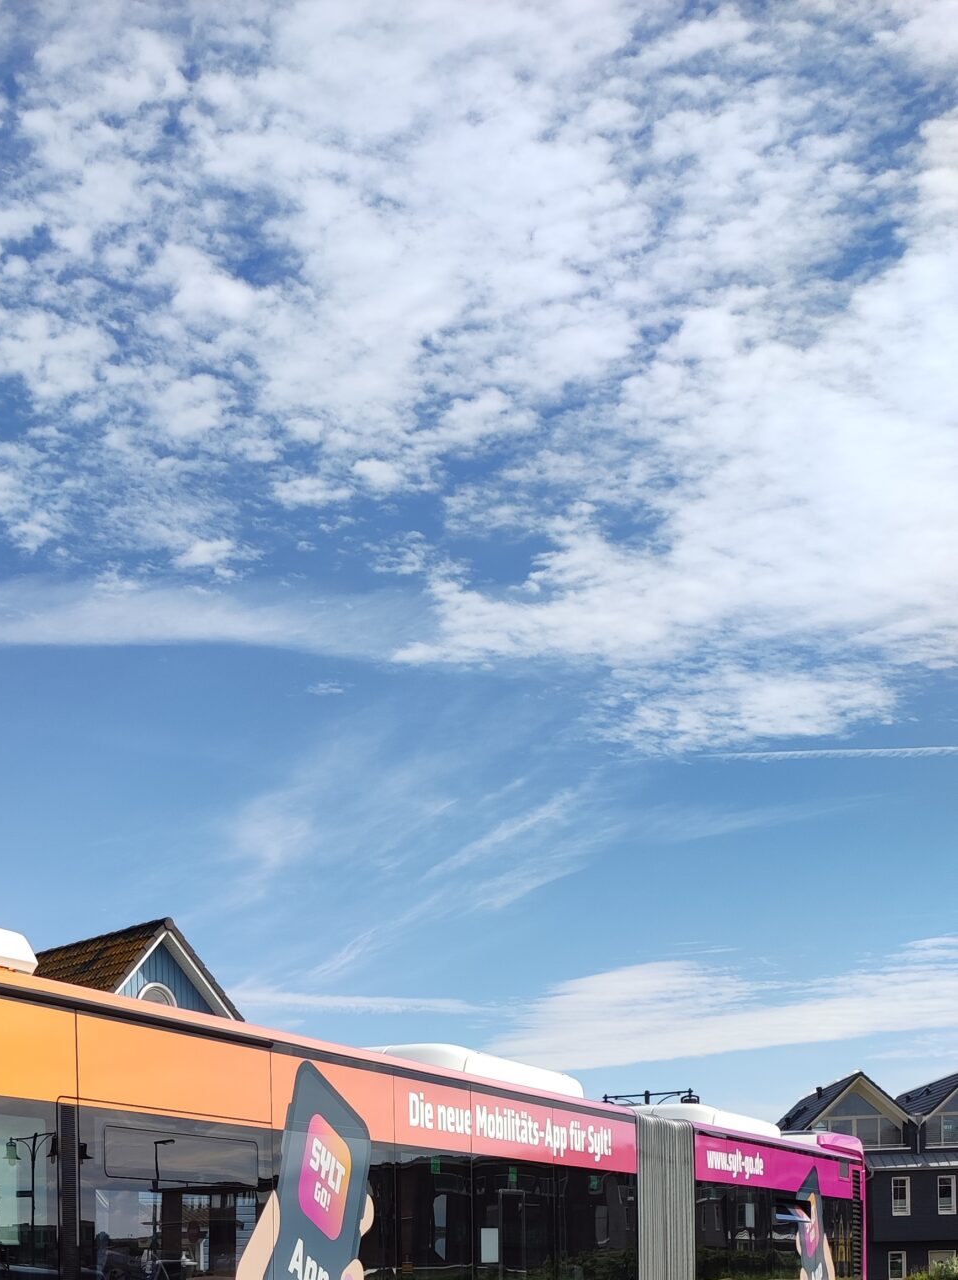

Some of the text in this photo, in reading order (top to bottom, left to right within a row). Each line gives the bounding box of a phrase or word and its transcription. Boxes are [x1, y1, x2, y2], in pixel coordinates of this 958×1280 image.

[408, 1091, 613, 1162] Die neue Mobilitäts-App für Sylt!
[309, 1136, 346, 1196] SYLT
[706, 1148, 764, 1180] www.sylt-go.de
[313, 1179, 332, 1213] GO!
